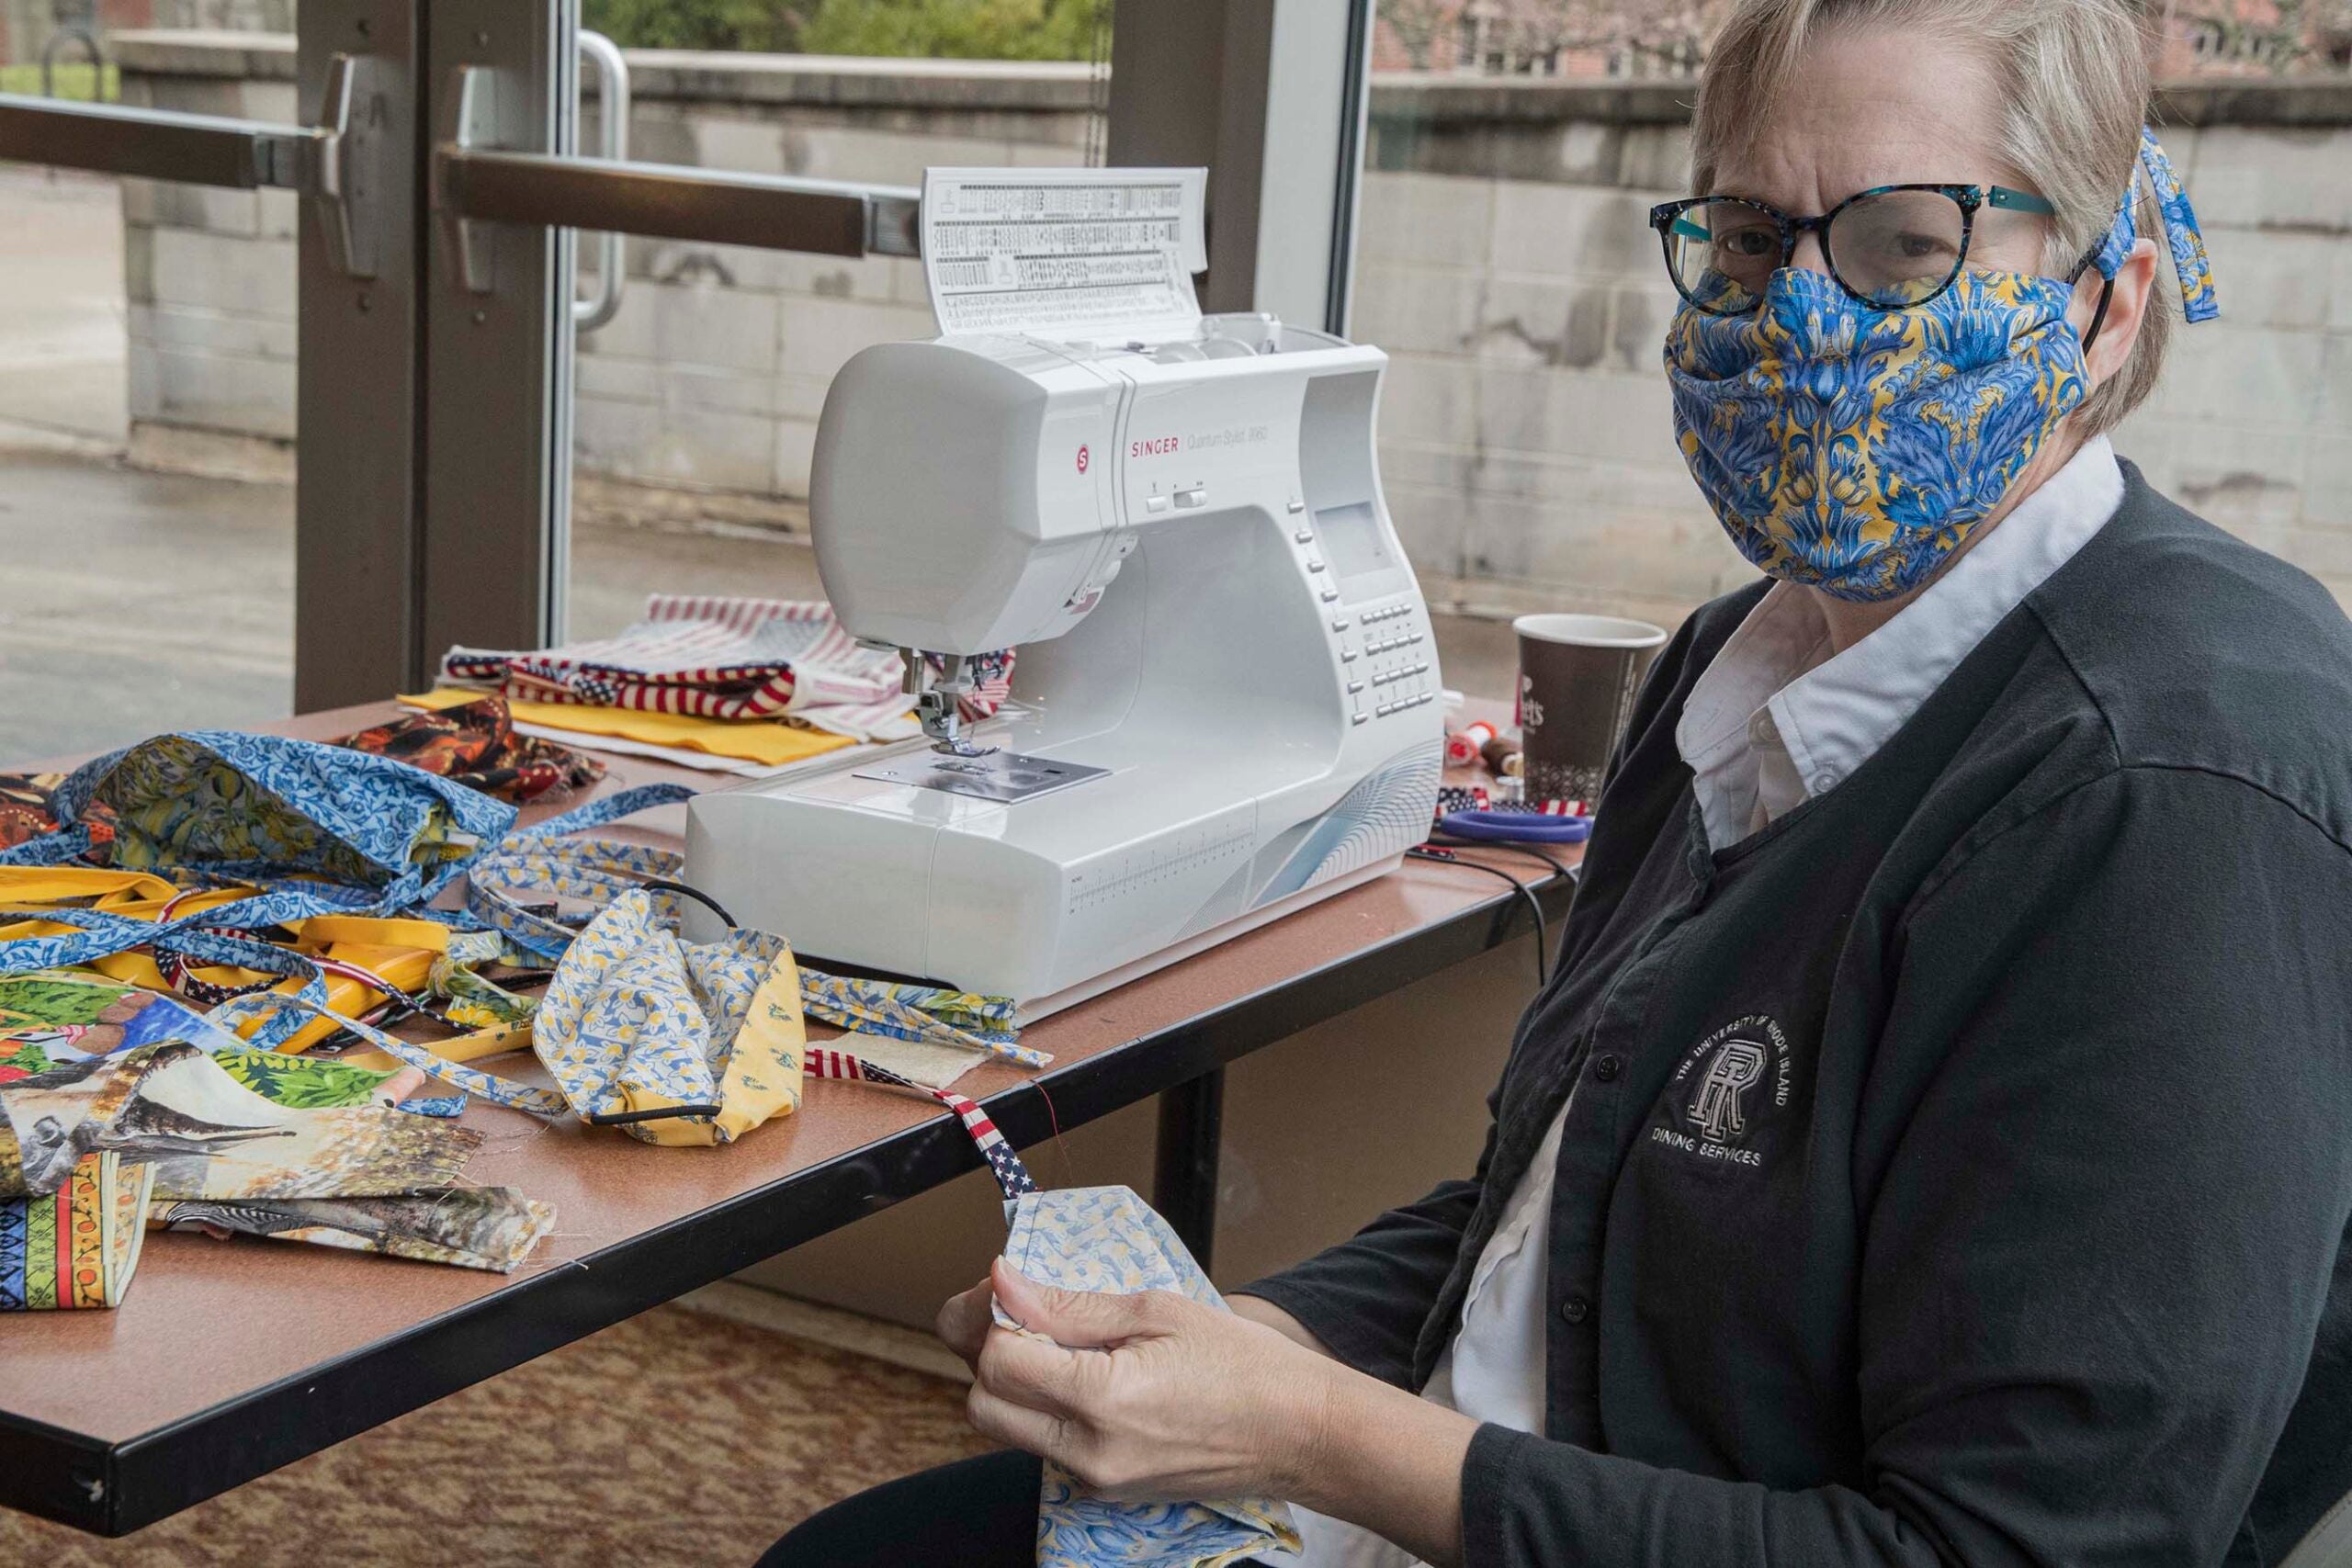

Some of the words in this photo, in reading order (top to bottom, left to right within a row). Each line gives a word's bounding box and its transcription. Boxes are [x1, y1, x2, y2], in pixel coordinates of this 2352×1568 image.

[1132, 436, 1180, 457] SINGER
[1674, 1058, 1694, 1081] THE
[1692, 1014, 1757, 1057] UNIVERSITY
[1774, 1055, 1791, 1107] ISLAND
[1651, 1126, 1697, 1152] DINING
[1699, 1142, 1762, 1168] SERVICES
